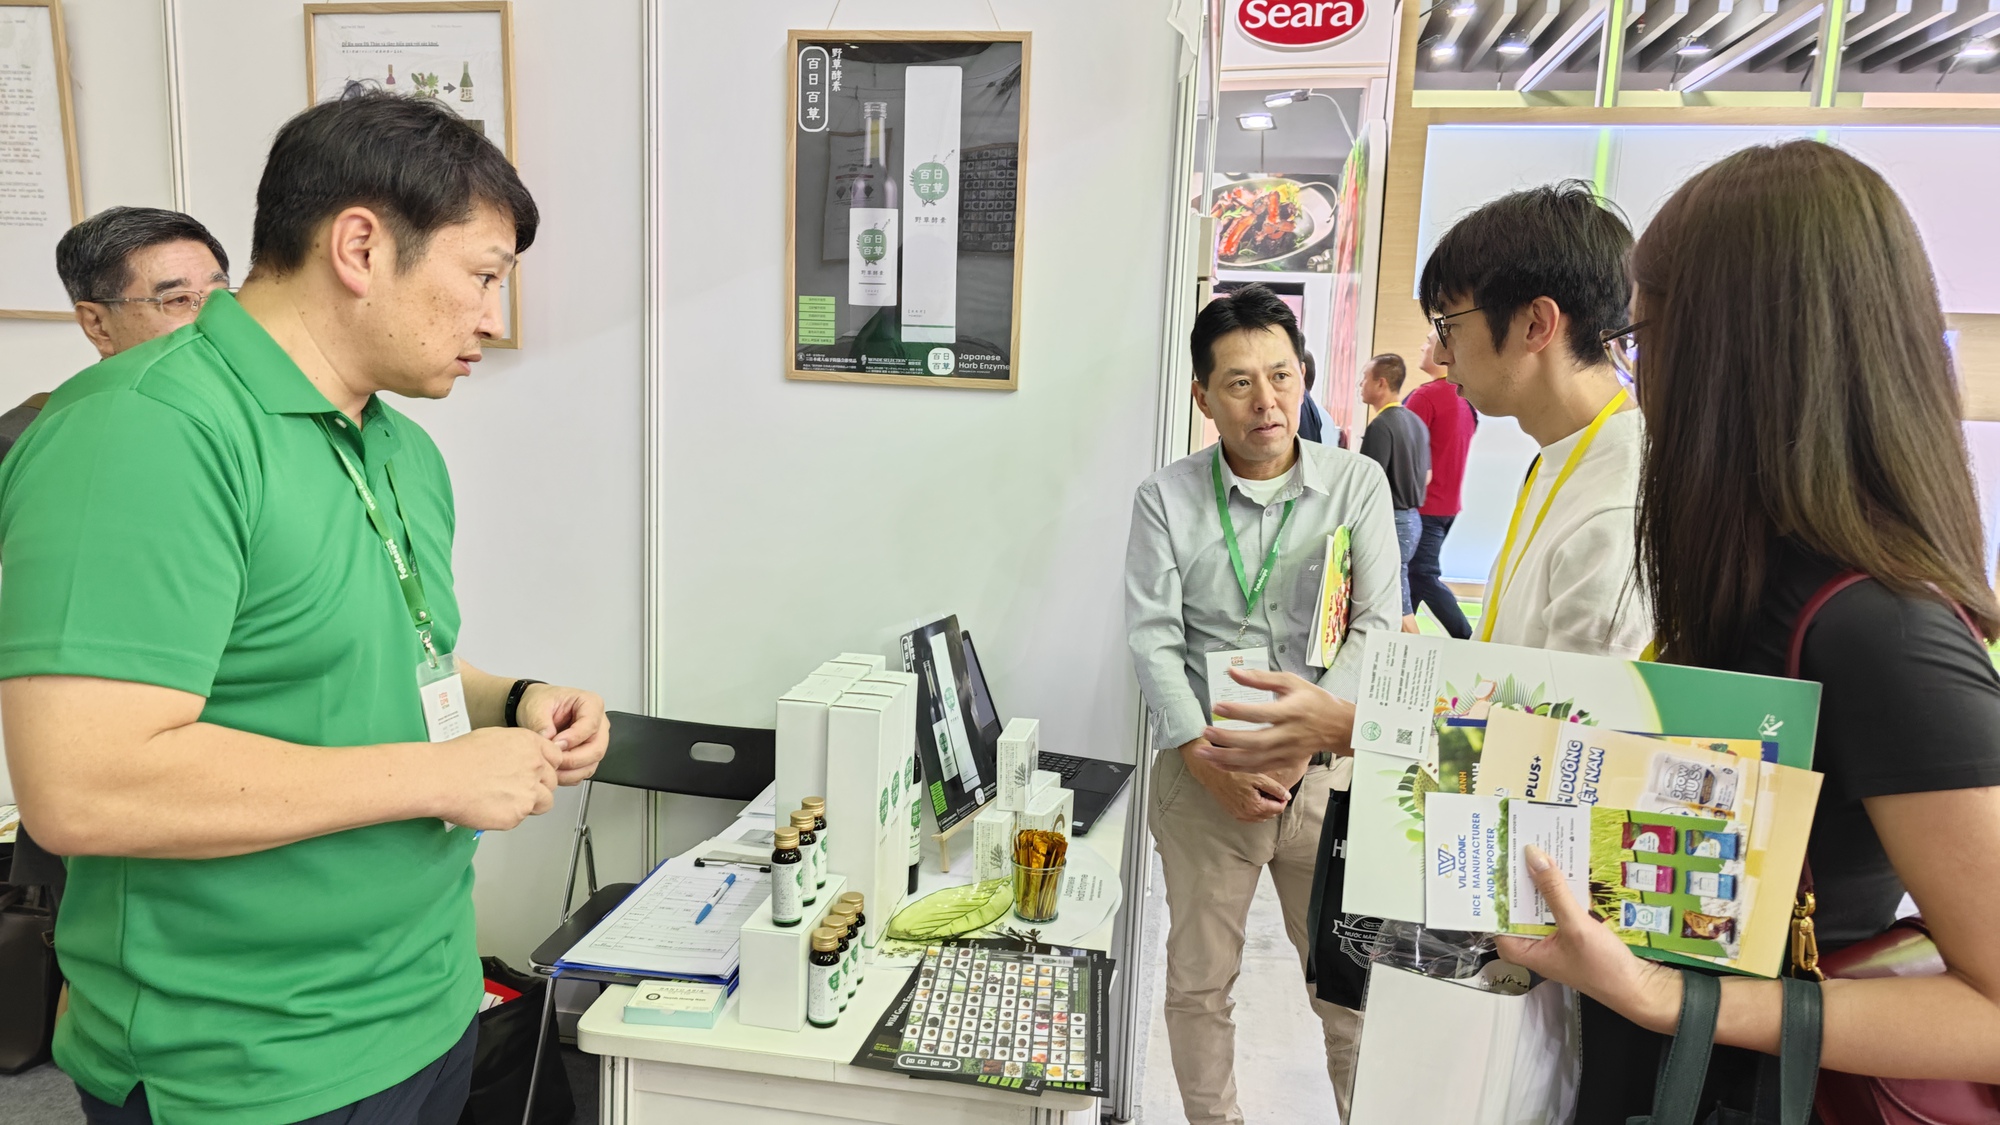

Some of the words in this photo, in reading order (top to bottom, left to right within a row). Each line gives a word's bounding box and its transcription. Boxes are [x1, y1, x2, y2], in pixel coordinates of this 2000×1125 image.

[1244, 0, 1354, 28] Seara
[831, 48, 842, 92] 野草酵素
[806, 57, 821, 120] 百日百草
[918, 168, 943, 180] 百日
[918, 182, 944, 194] 百草
[862, 234, 883, 244] 百日
[862, 246, 884, 256] 百草
[958, 353, 1001, 363] Japanese
[958, 362, 979, 370] Harb
[980, 362, 1010, 371] Enzyme
[1525, 755, 1542, 798] PLUS+
[1559, 740, 1583, 794] DƯỠNG
[1584, 747, 1604, 783] NAM
[1458, 834, 1467, 889] VILACONIC
[1472, 812, 1480, 889] MANUFACTURER
[1486, 828, 1495, 874] EXPORTER
[1487, 878, 1495, 899] AND
[1472, 894, 1480, 916] RICE
